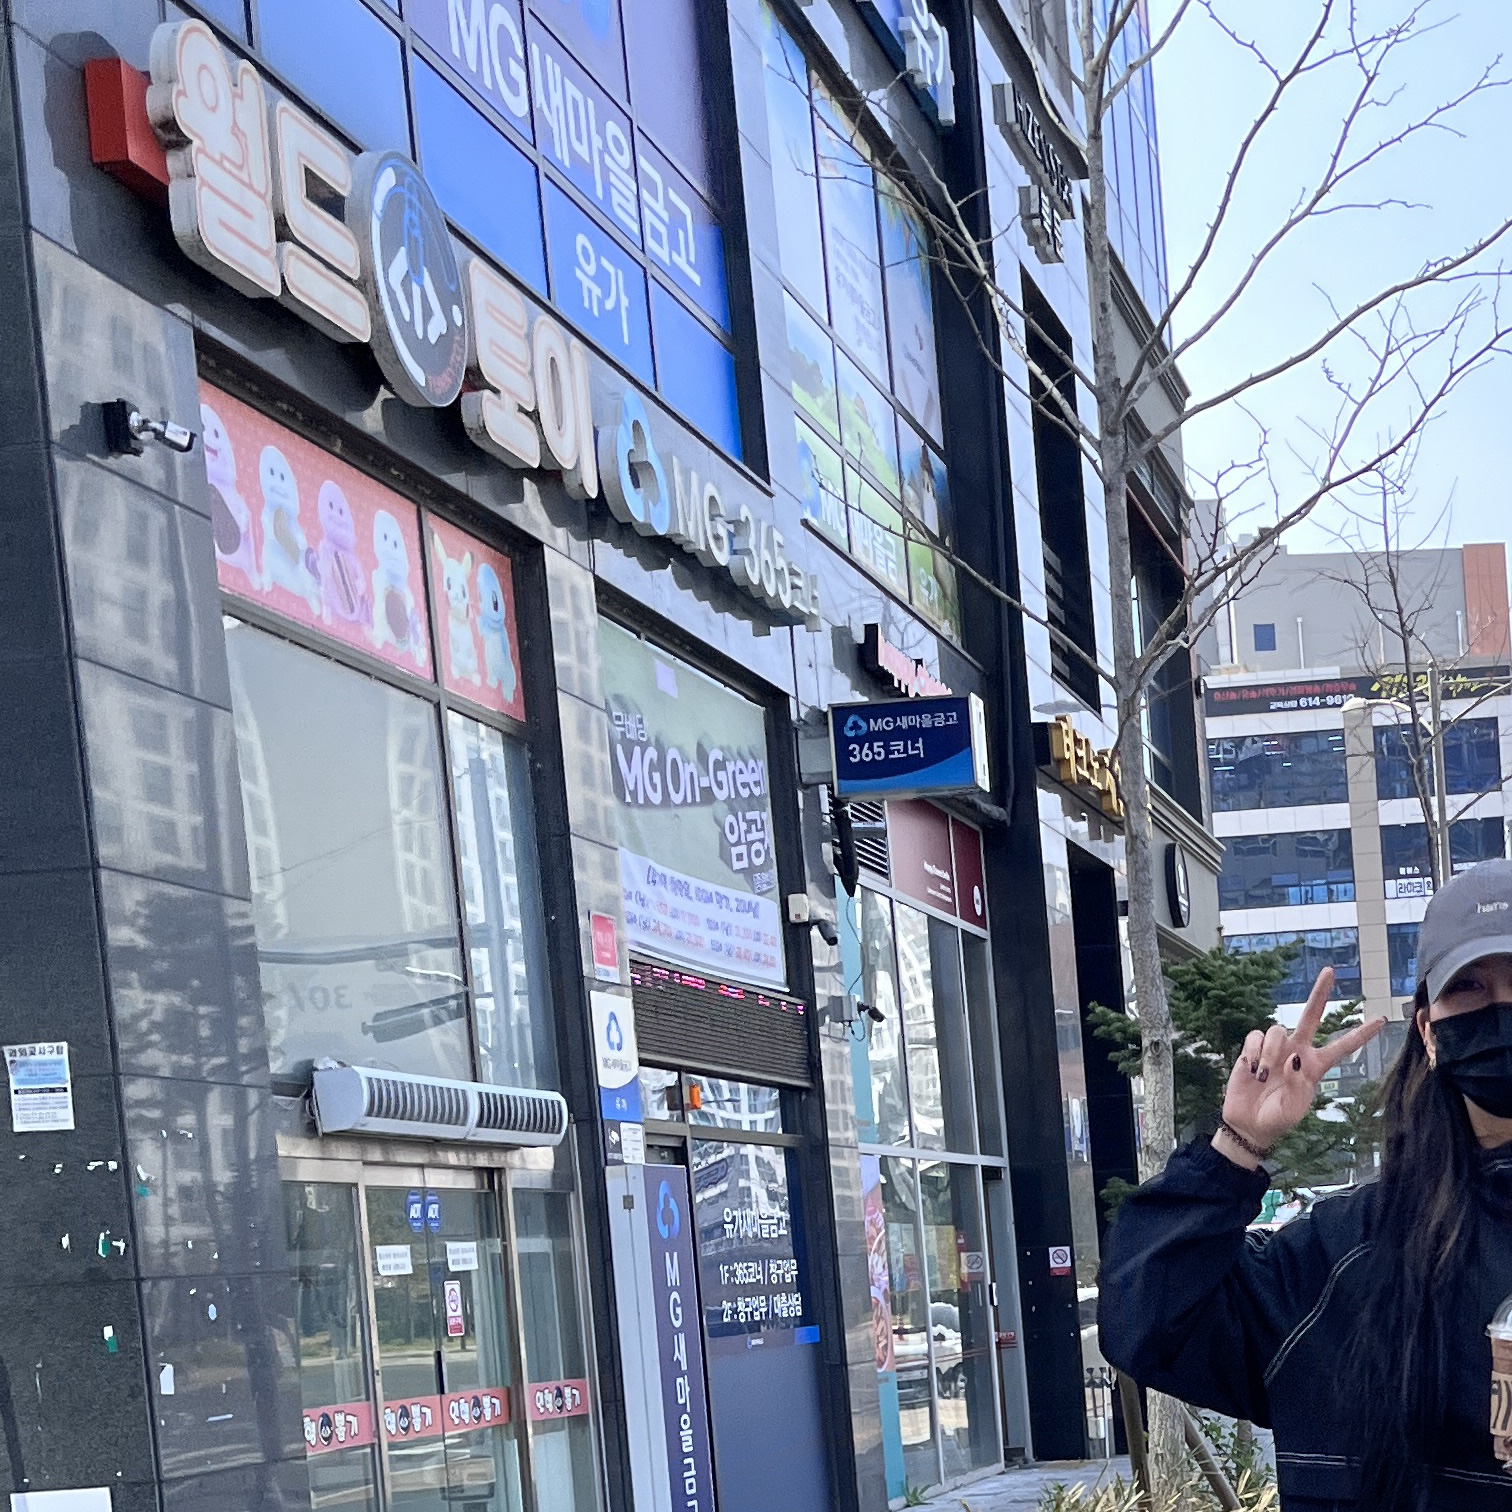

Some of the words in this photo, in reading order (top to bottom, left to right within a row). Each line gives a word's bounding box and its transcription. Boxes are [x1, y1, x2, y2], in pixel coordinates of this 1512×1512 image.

[575, 233, 629, 345] 유가
[465, 257, 599, 498] 토이
[613, 711, 648, 742] 무배당
[869, 711, 959, 732] MG새마을금고
[616, 744, 662, 804] MG
[666, 748, 768, 805] On-Green
